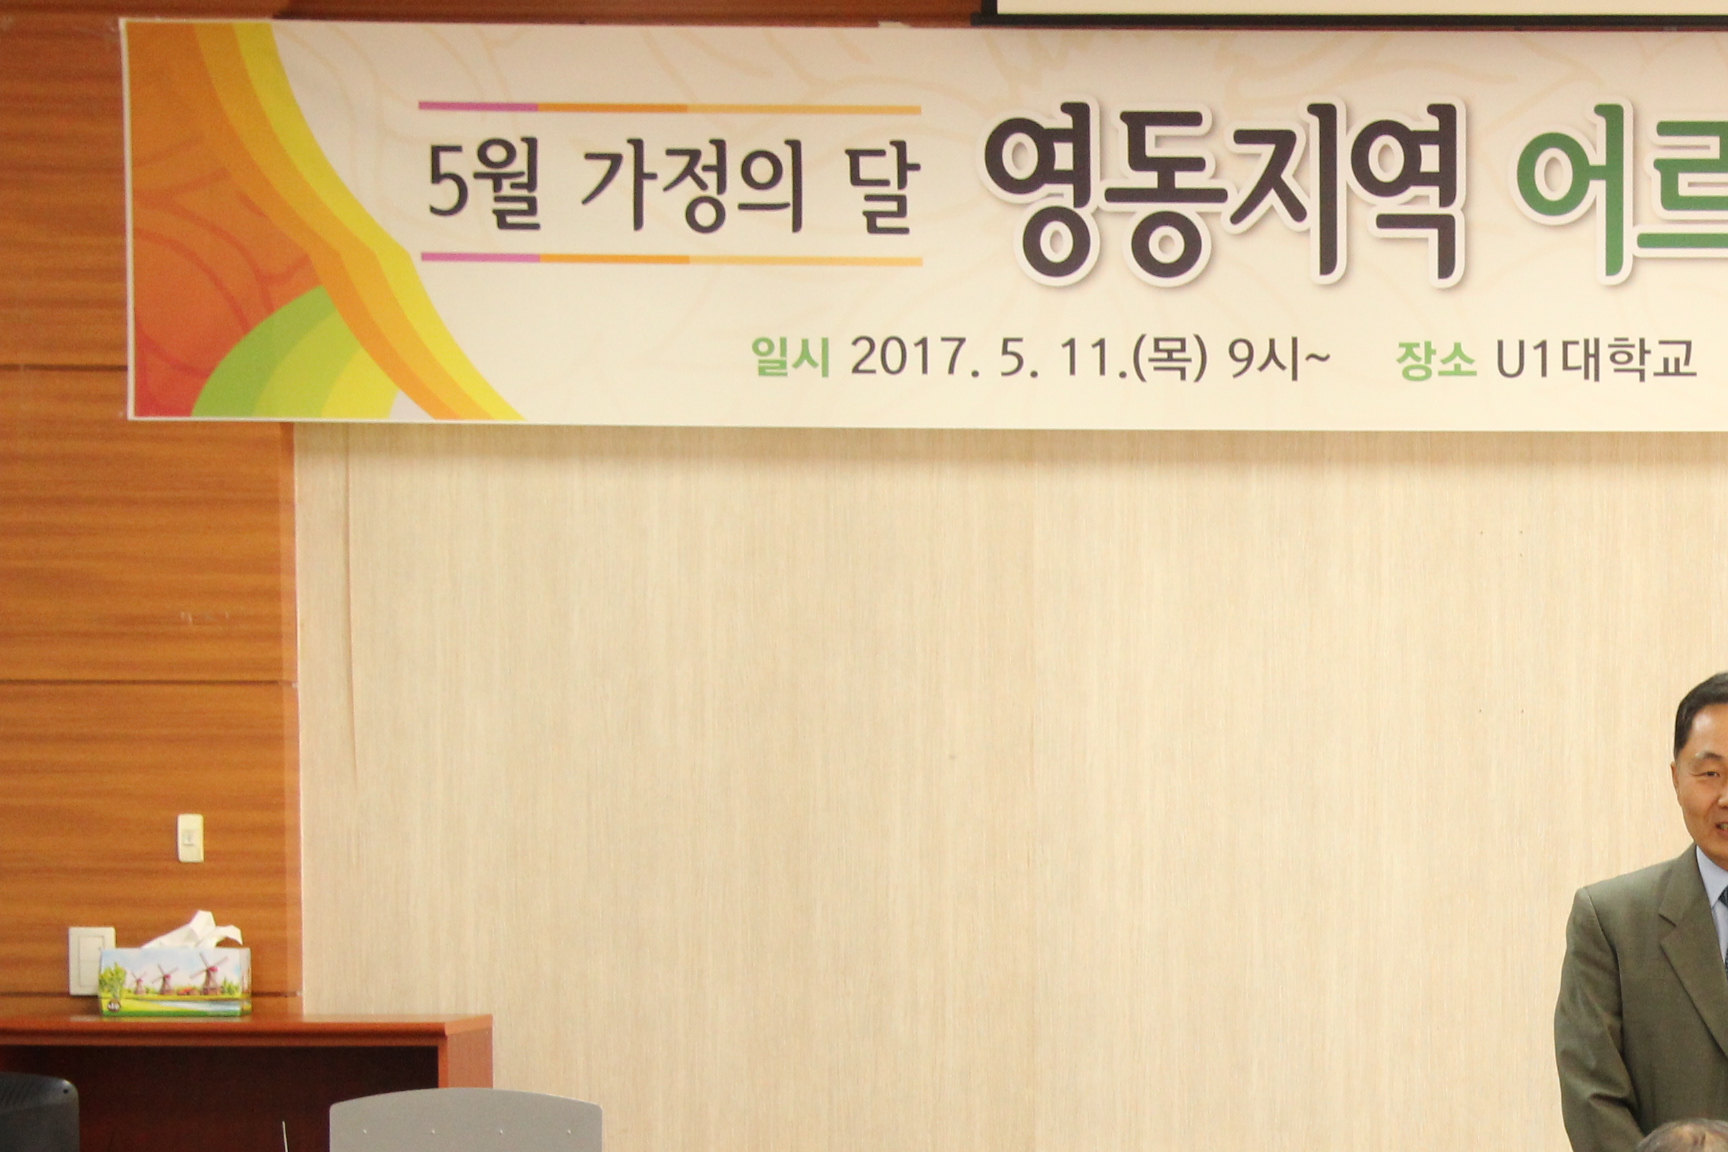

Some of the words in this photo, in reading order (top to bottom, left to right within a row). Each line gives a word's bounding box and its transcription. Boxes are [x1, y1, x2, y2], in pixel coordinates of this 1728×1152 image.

[429, 135, 541, 231] 5월
[581, 138, 803, 235] 가정의
[845, 139, 922, 235] 달
[984, 101, 1465, 281] 영동지역
[751, 336, 830, 378] 일시
[850, 335, 980, 378] 2017.
[1000, 337, 1039, 379] 5.
[1061, 333, 1208, 383] 11.(목)
[1228, 336, 1331, 382] 9시~
[1396, 341, 1477, 382] 장소
[1496, 337, 1699, 383] U1대학교
